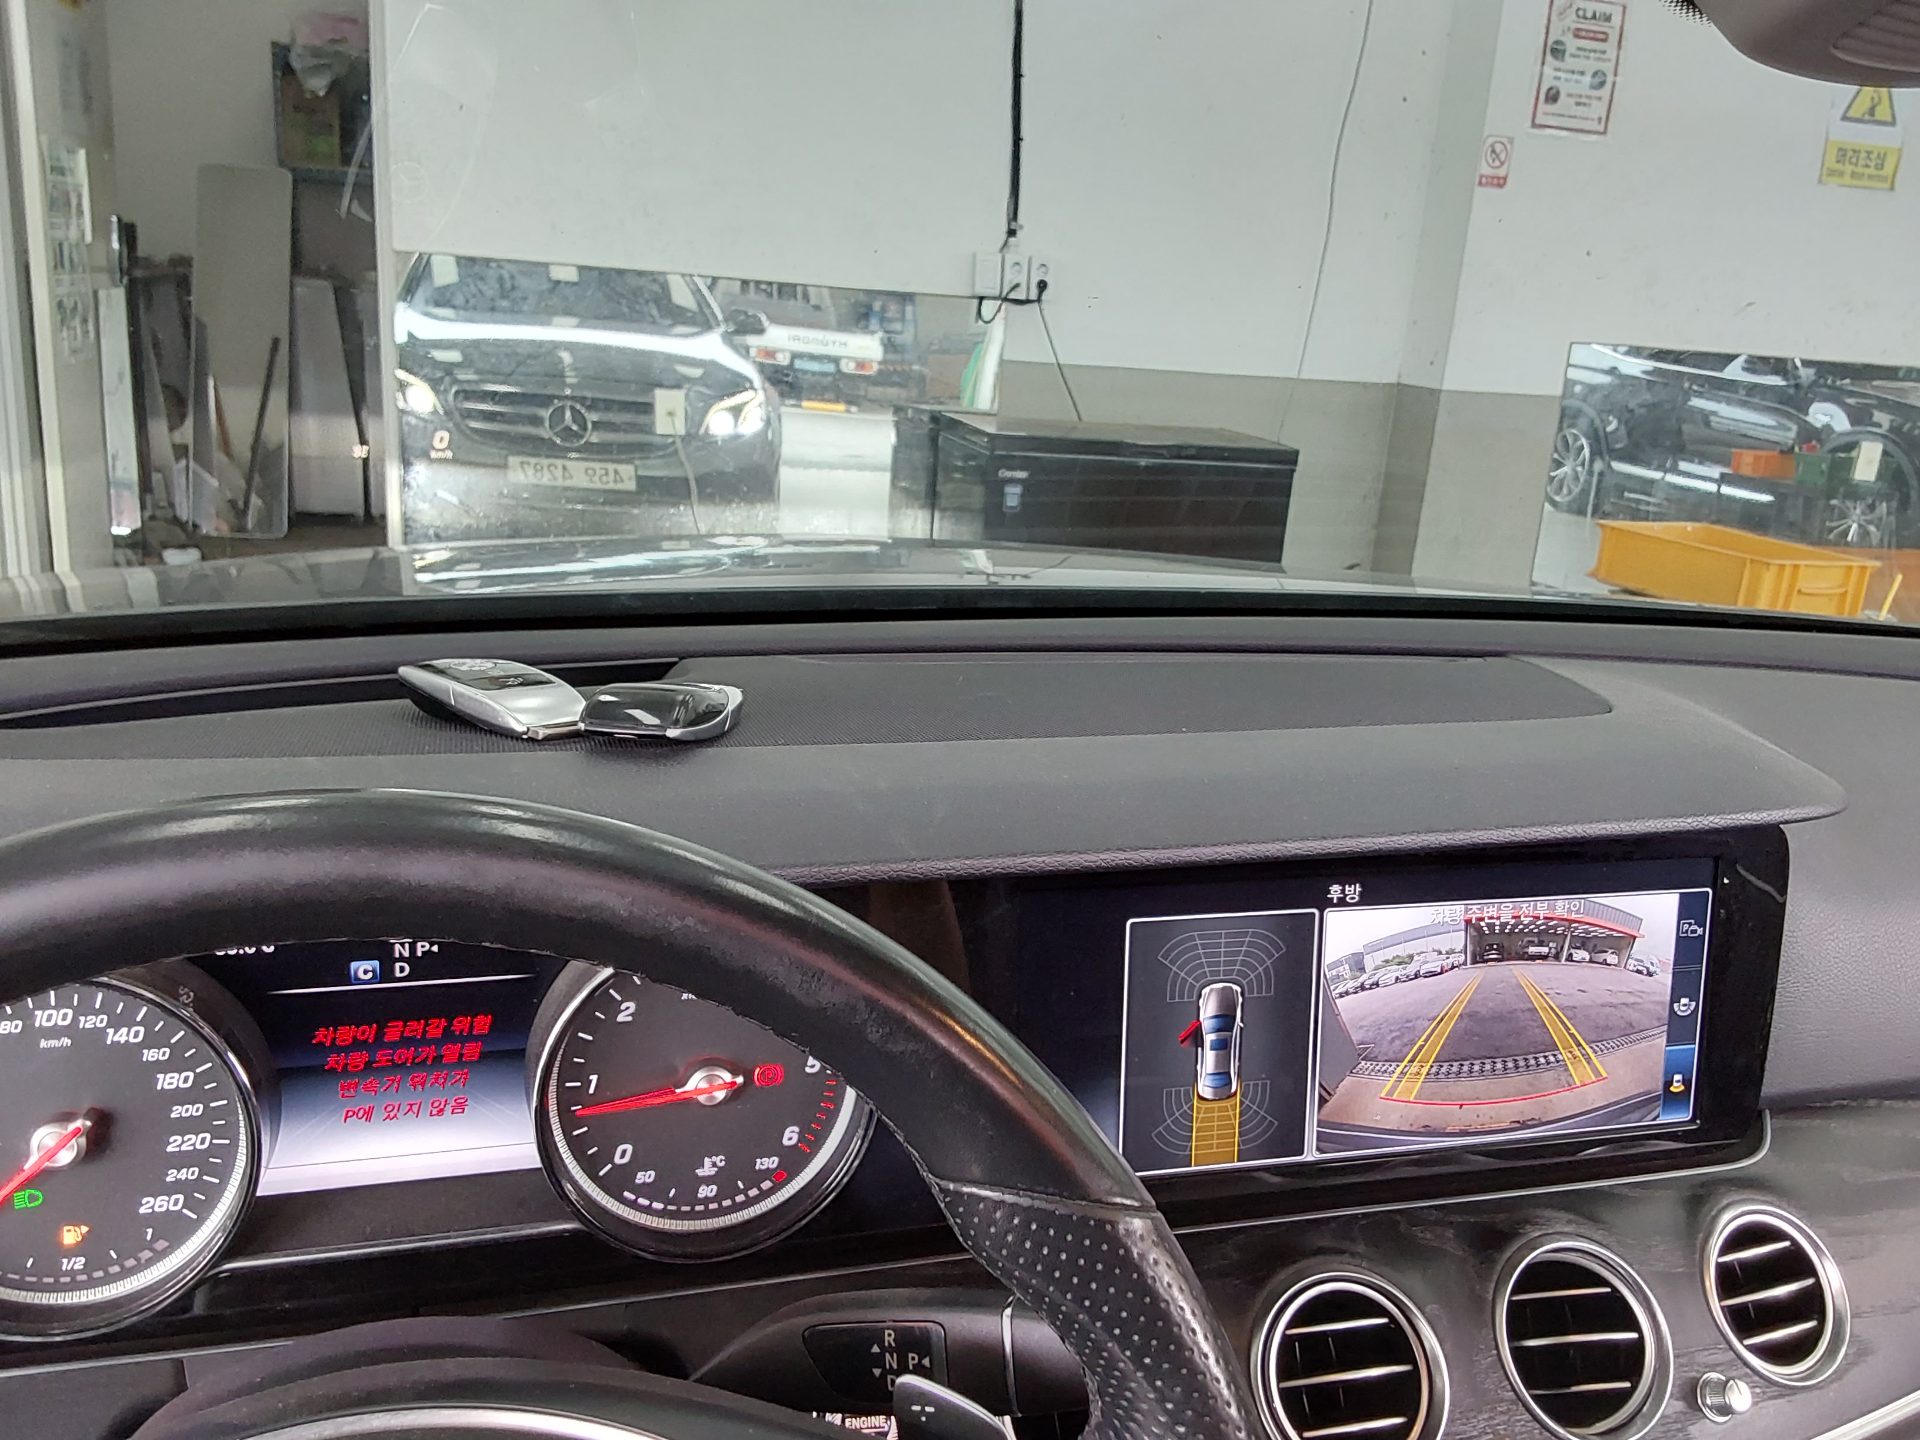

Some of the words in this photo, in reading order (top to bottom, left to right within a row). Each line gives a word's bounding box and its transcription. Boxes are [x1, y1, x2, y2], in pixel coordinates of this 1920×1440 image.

[1575, 7, 1613, 24] CLAIM
[1836, 147, 1888, 171] 머리조심
[1326, 883, 1362, 904] 후방
[1430, 905, 1464, 925] 차량
[1466, 903, 1515, 924] 주변을
[1519, 903, 1550, 922] 전부
[1553, 899, 1585, 918] 확인
[394, 942, 410, 958] N
[416, 941, 430, 957] P
[394, 962, 410, 977] D
[34, 1008, 73, 1028] 100
[616, 1001, 636, 1023] 2
[0, 1020, 23, 1034] 80
[78, 1014, 108, 1029] 120
[312, 1023, 378, 1047] 차량이
[383, 1017, 448, 1042] 굴러갈
[450, 1014, 493, 1036] 위험
[40, 1037, 72, 1048] km/h
[105, 1026, 145, 1045] 140
[142, 1047, 171, 1062] 160
[324, 1050, 369, 1073] 차량
[372, 1044, 438, 1068] 도어가
[440, 1040, 483, 1064] 열림
[804, 1056, 821, 1074] 5
[156, 1071, 195, 1091] 180
[338, 1074, 403, 1099] 변속기
[407, 1068, 470, 1092] 위치가
[588, 1074, 599, 1094] 1
[170, 1103, 204, 1119] 200
[343, 1103, 375, 1124] P에
[382, 1100, 422, 1122] 있지
[428, 1095, 470, 1118] 않음
[165, 1132, 212, 1153] 220
[782, 1125, 800, 1147] 6
[613, 1143, 633, 1165] 0
[755, 1156, 780, 1170] 130
[165, 1167, 199, 1182] 240
[635, 1170, 656, 1184] 50
[697, 1184, 718, 1198] 90
[139, 1194, 185, 1214] 260
[61, 1257, 86, 1271] 1/2
[884, 1329, 896, 1348] R
[885, 1352, 898, 1370] N
[908, 1353, 919, 1370] P
[845, 1415, 887, 1430] ENGINE
